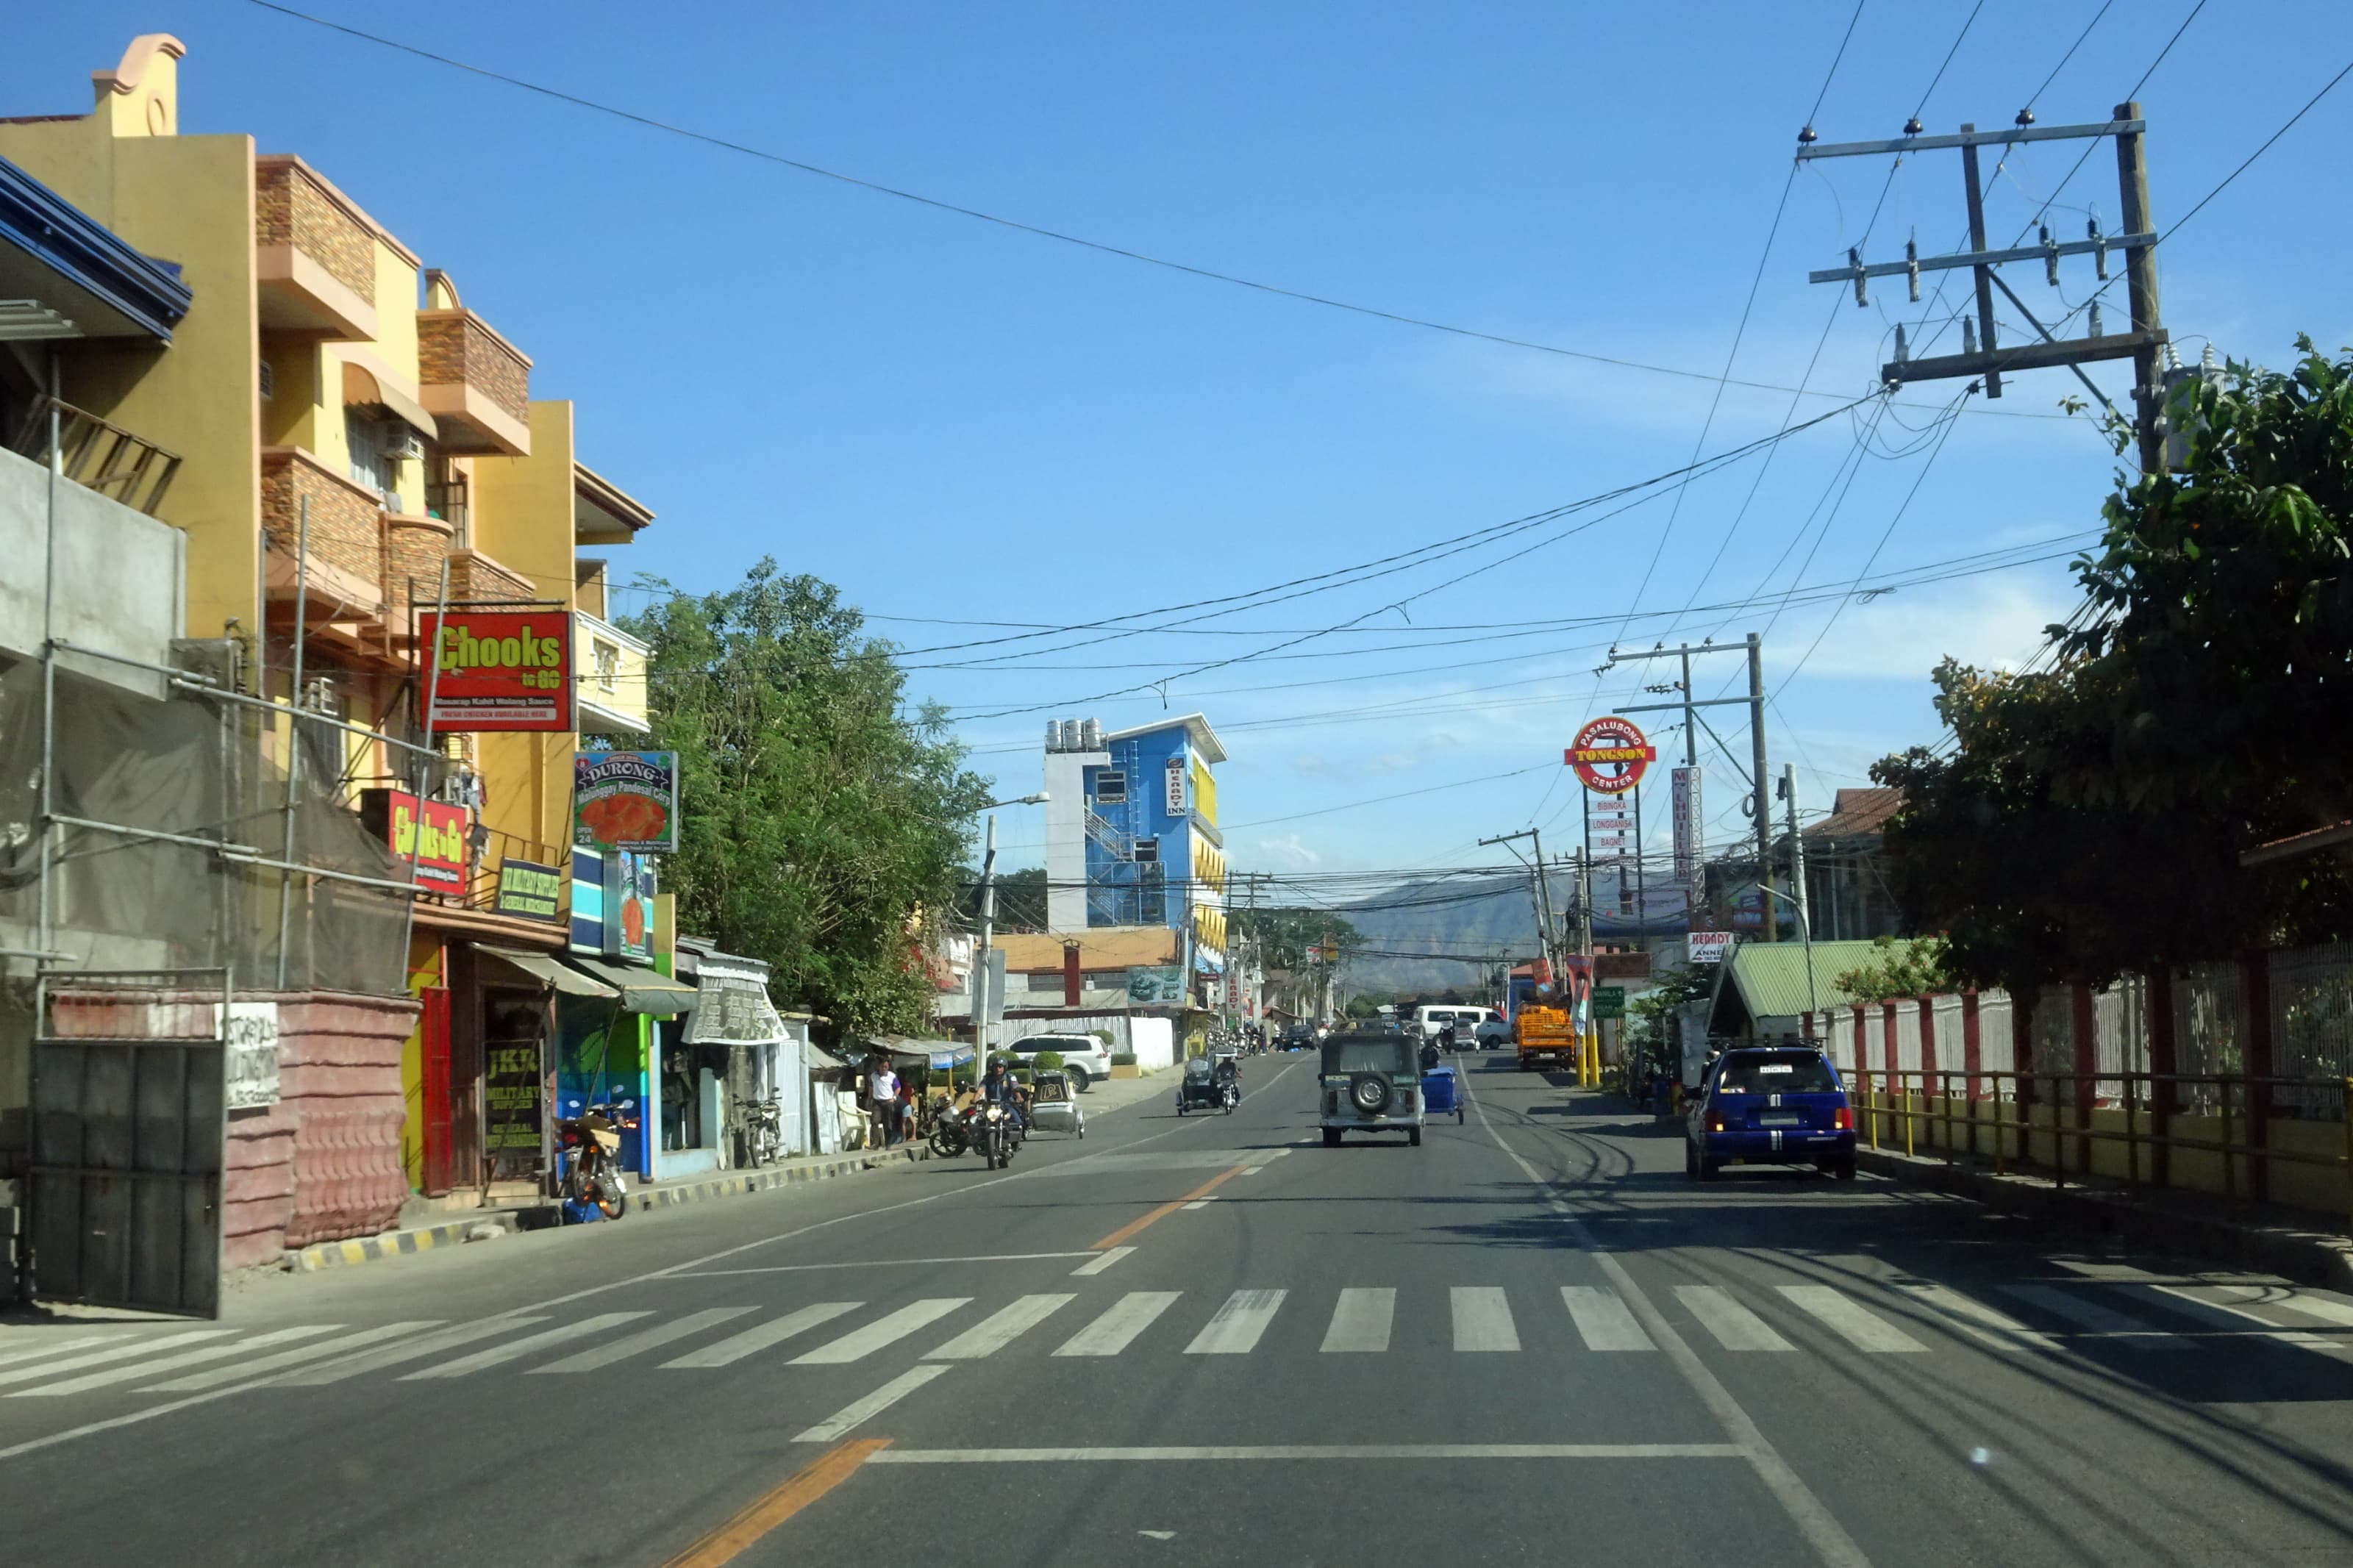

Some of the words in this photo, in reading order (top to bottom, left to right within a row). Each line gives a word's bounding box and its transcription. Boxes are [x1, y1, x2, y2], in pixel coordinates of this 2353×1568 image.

[432, 625, 560, 670] Chooks
[522, 672, 535, 686] to
[1580, 721, 1641, 746] PASALUBONG
[1576, 748, 1646, 761] TONGSON
[588, 762, 658, 781] DURONG
[1592, 775, 1633, 788] CENTER
[618, 781, 652, 796] Pandesal
[653, 787, 671, 806] Corp
[1597, 801, 1627, 811] BIBINGKA
[1593, 820, 1632, 829] LONGGANISA
[578, 835, 591, 843] 24
[1601, 838, 1624, 846] BAGNET
